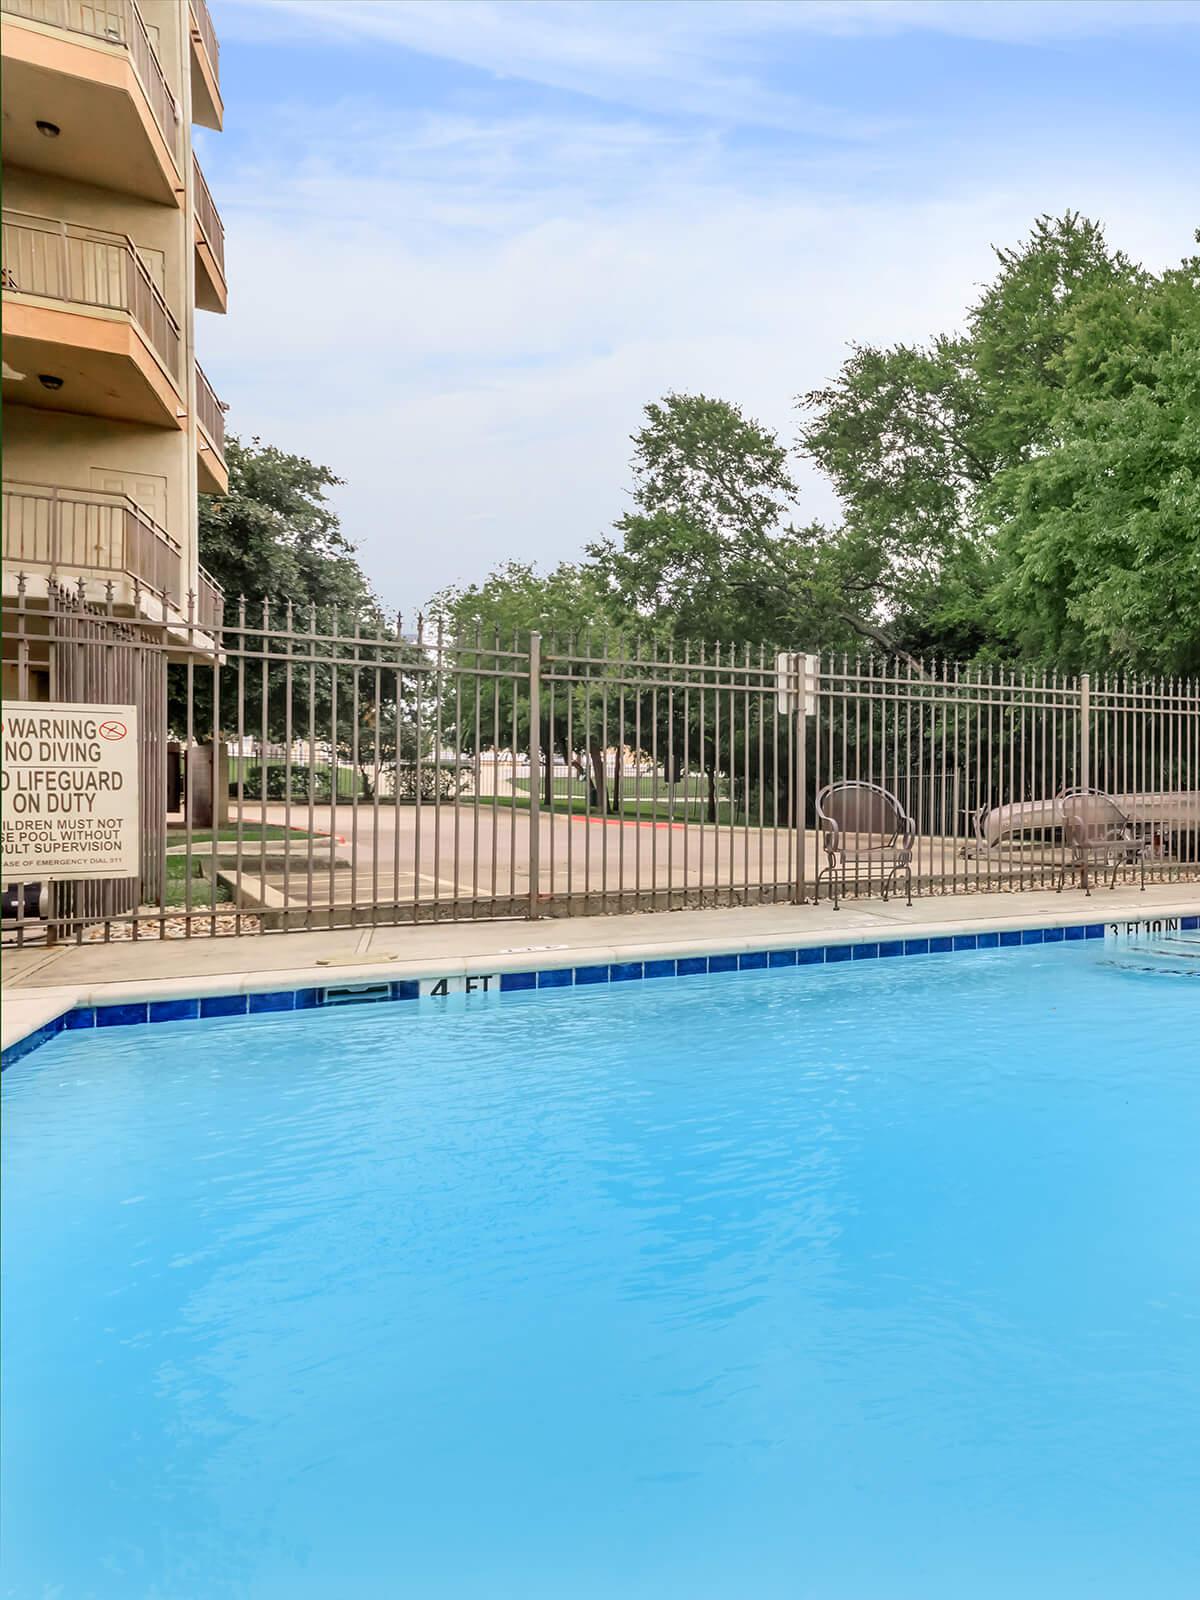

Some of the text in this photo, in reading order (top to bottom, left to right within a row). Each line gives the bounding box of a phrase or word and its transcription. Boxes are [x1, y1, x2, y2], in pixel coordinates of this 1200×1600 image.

[8, 718, 97, 740] WARNING
[5, 741, 101, 763] NO DIVING
[17, 771, 123, 791] LIFEGUARD
[13, 793, 96, 813] ON DUTY
[57, 819, 94, 830] MUST
[97, 818, 124, 829] NOT
[19, 831, 56, 841] POOL
[60, 829, 120, 840] WITHOUT
[1, 841, 122, 854] ULT SUPERVISION
[1109, 918, 1178, 936] 3 FT 10 IN
[430, 975, 493, 996] 4 FT
